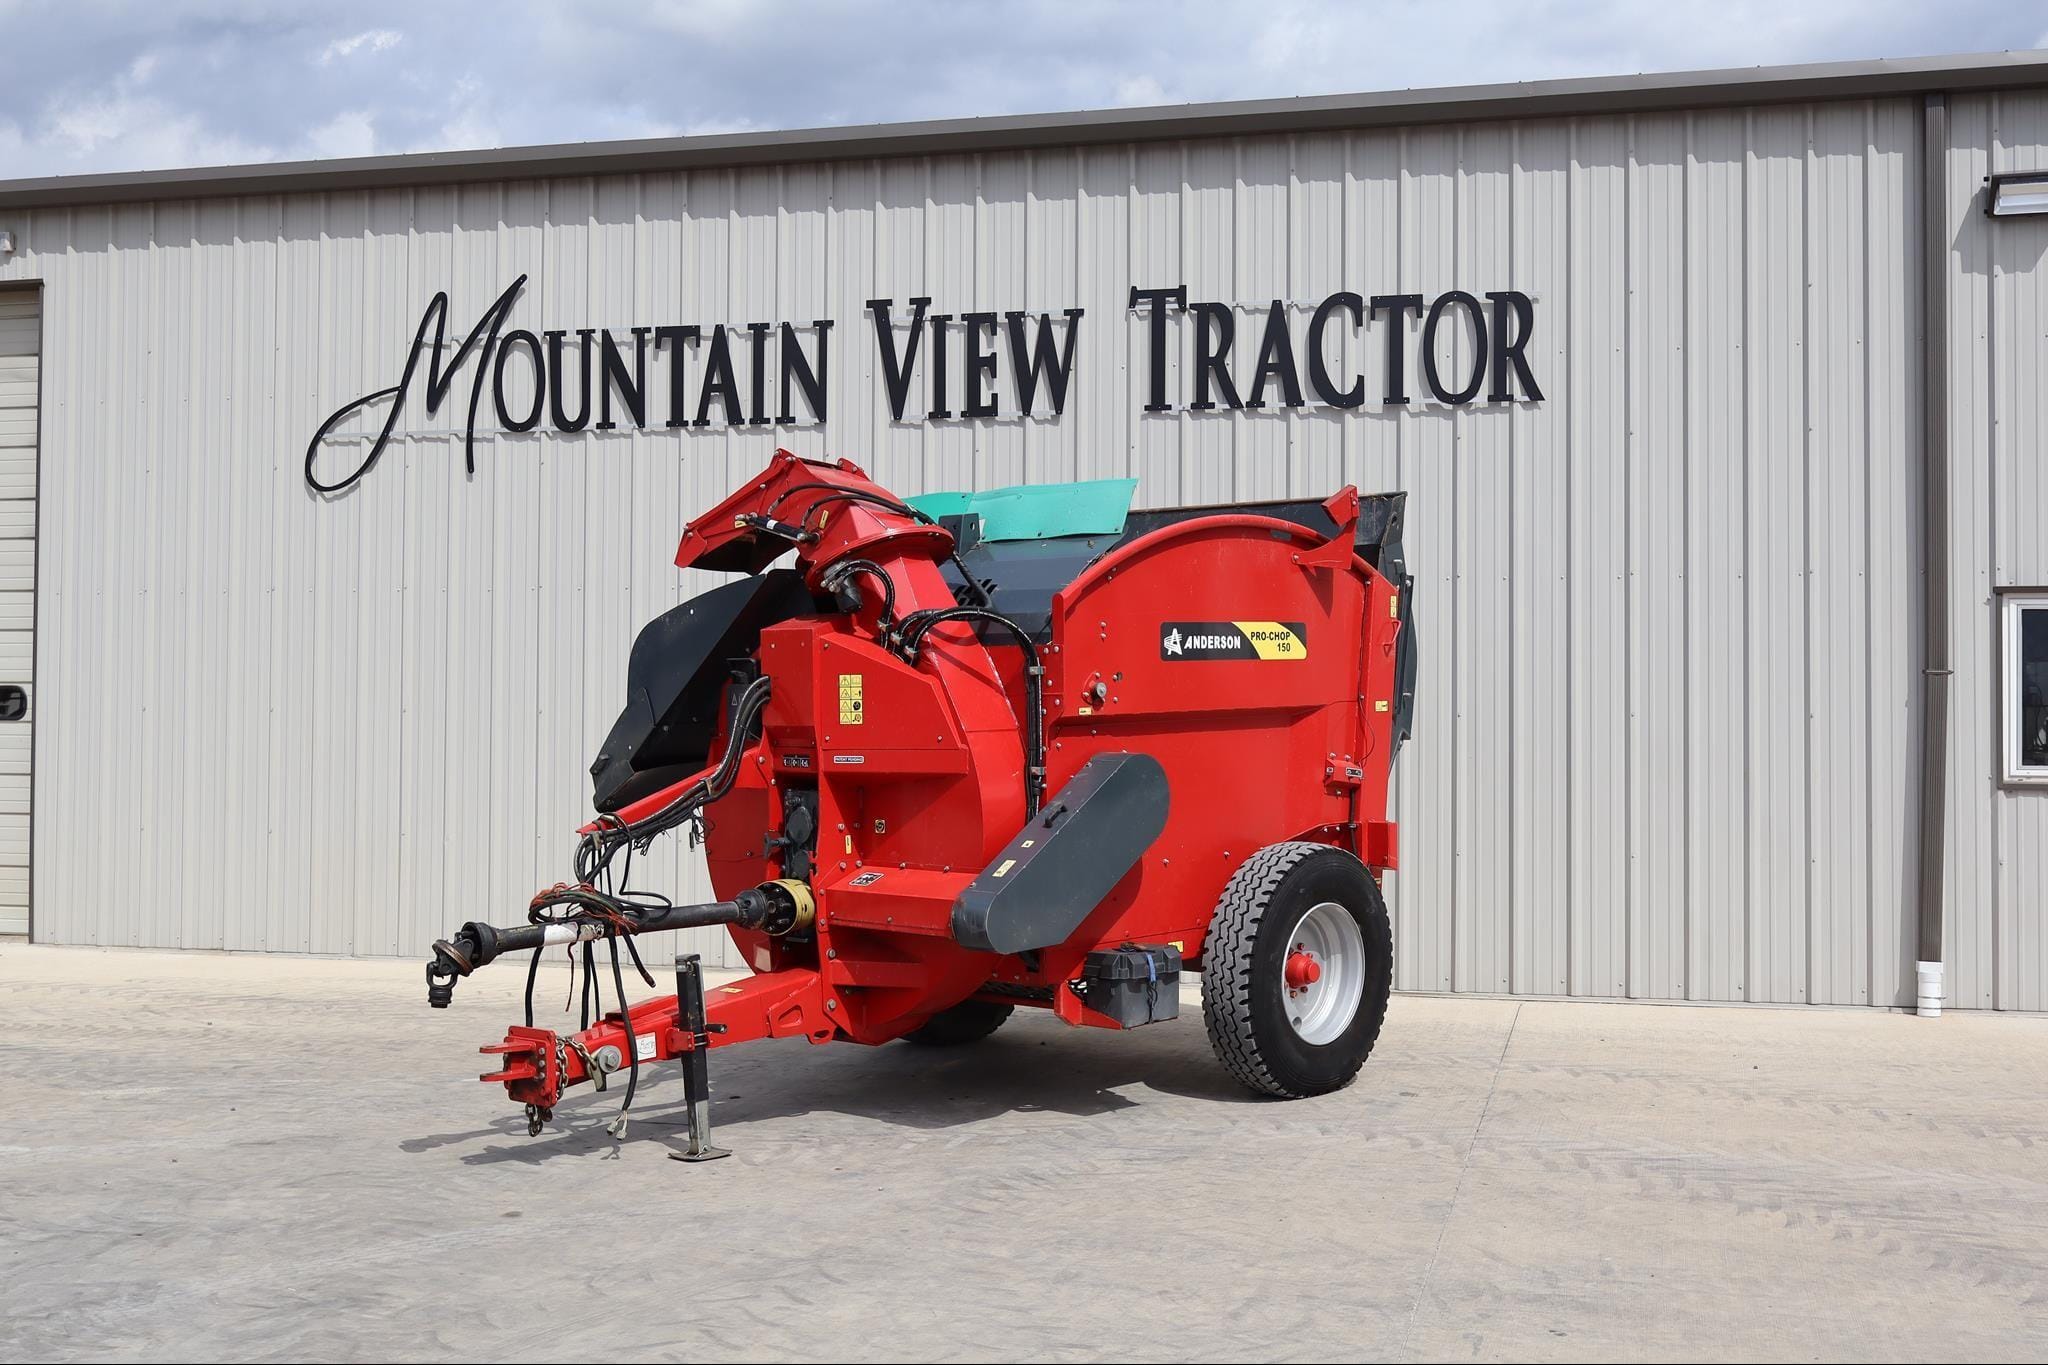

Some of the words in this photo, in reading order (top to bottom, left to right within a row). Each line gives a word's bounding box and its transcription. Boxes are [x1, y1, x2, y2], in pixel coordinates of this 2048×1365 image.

[304, 273, 835, 493] MOUNTAIN
[865, 296, 1085, 422] VIEW
[1128, 284, 1546, 413] TRACTOR
[1184, 635, 1241, 649] ANDERSON
[1250, 631, 1291, 641] PRO-CHOP
[1277, 643, 1291, 652] 150
